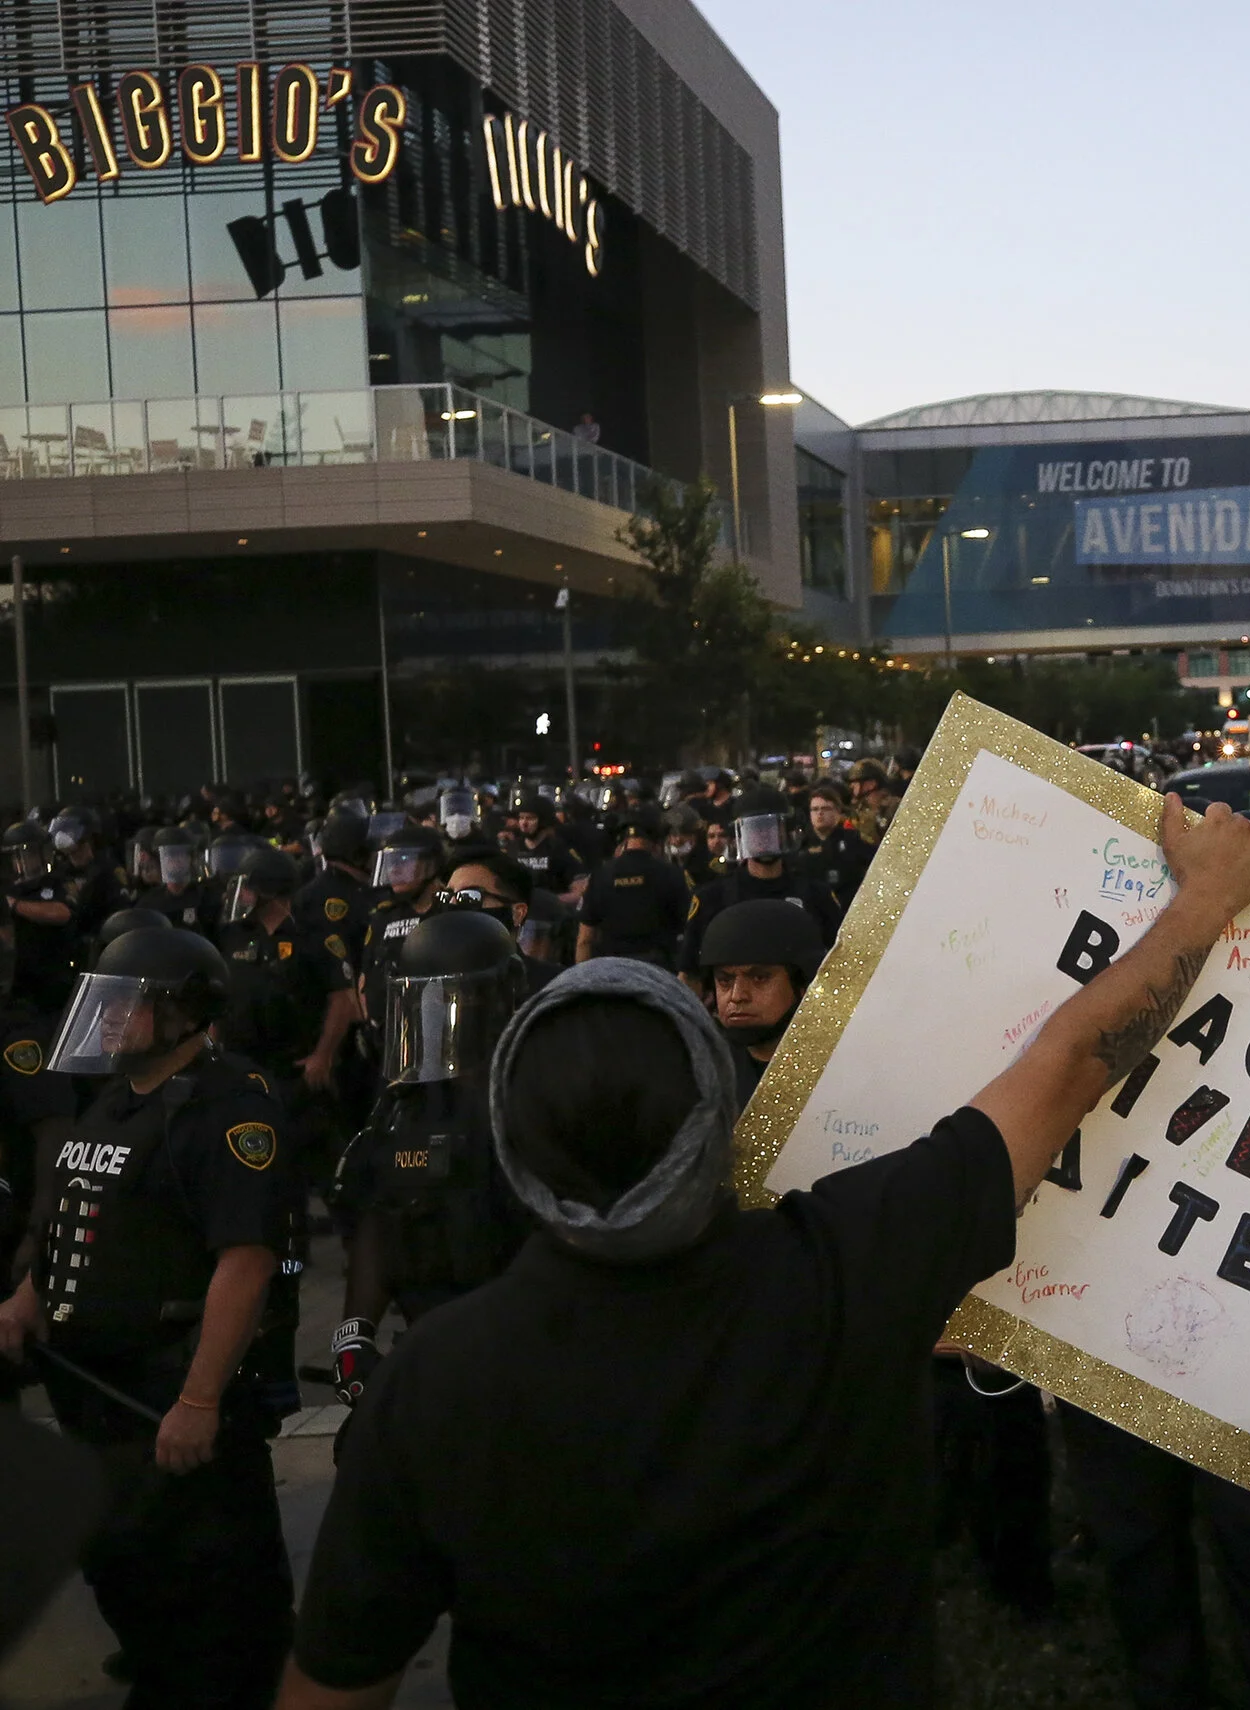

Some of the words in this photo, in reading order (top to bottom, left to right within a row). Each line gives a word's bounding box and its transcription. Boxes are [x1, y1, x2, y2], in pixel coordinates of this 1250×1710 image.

[6, 62, 407, 206] BIGGIO'S
[1038, 458, 1155, 493] WELCOME
[1161, 456, 1191, 488] TO
[1156, 578, 1240, 598] DOWNTOWN'S
[56, 1140, 132, 1175] POLICE
[394, 1150, 429, 1169] POLICE
[1016, 1261, 1049, 1288] Eric
[1022, 1284, 1090, 1304] Garner
